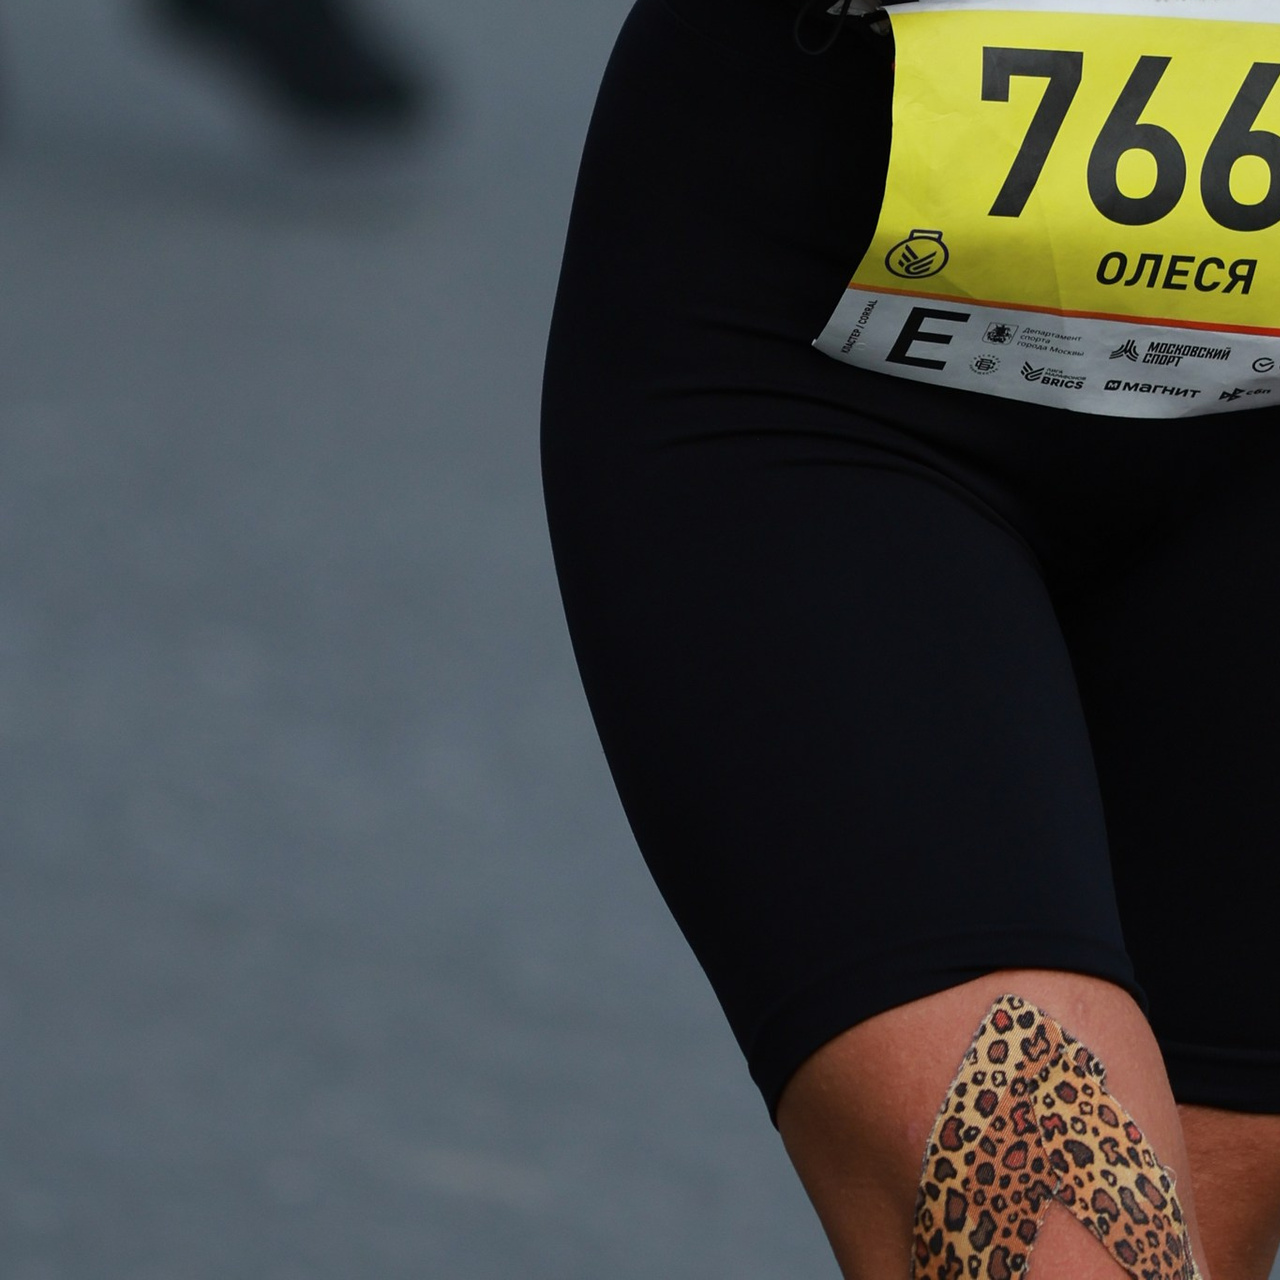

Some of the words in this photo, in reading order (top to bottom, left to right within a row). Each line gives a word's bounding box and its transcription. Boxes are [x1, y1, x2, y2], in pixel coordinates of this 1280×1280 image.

[1095, 251, 1258, 295] ОЛЕСЯ
[858, 299, 878, 325] CORRAL
[885, 306, 971, 371] E
[1020, 334, 1051, 345] спорта
[1022, 327, 1082, 341] Департамент
[1016, 340, 1048, 352] города
[1049, 346, 1085, 357] Москвы
[1147, 341, 1232, 361] МОСКОВСКИЙ
[1142, 353, 1184, 367] СПОРТ
[1041, 376, 1084, 389] BRICS
